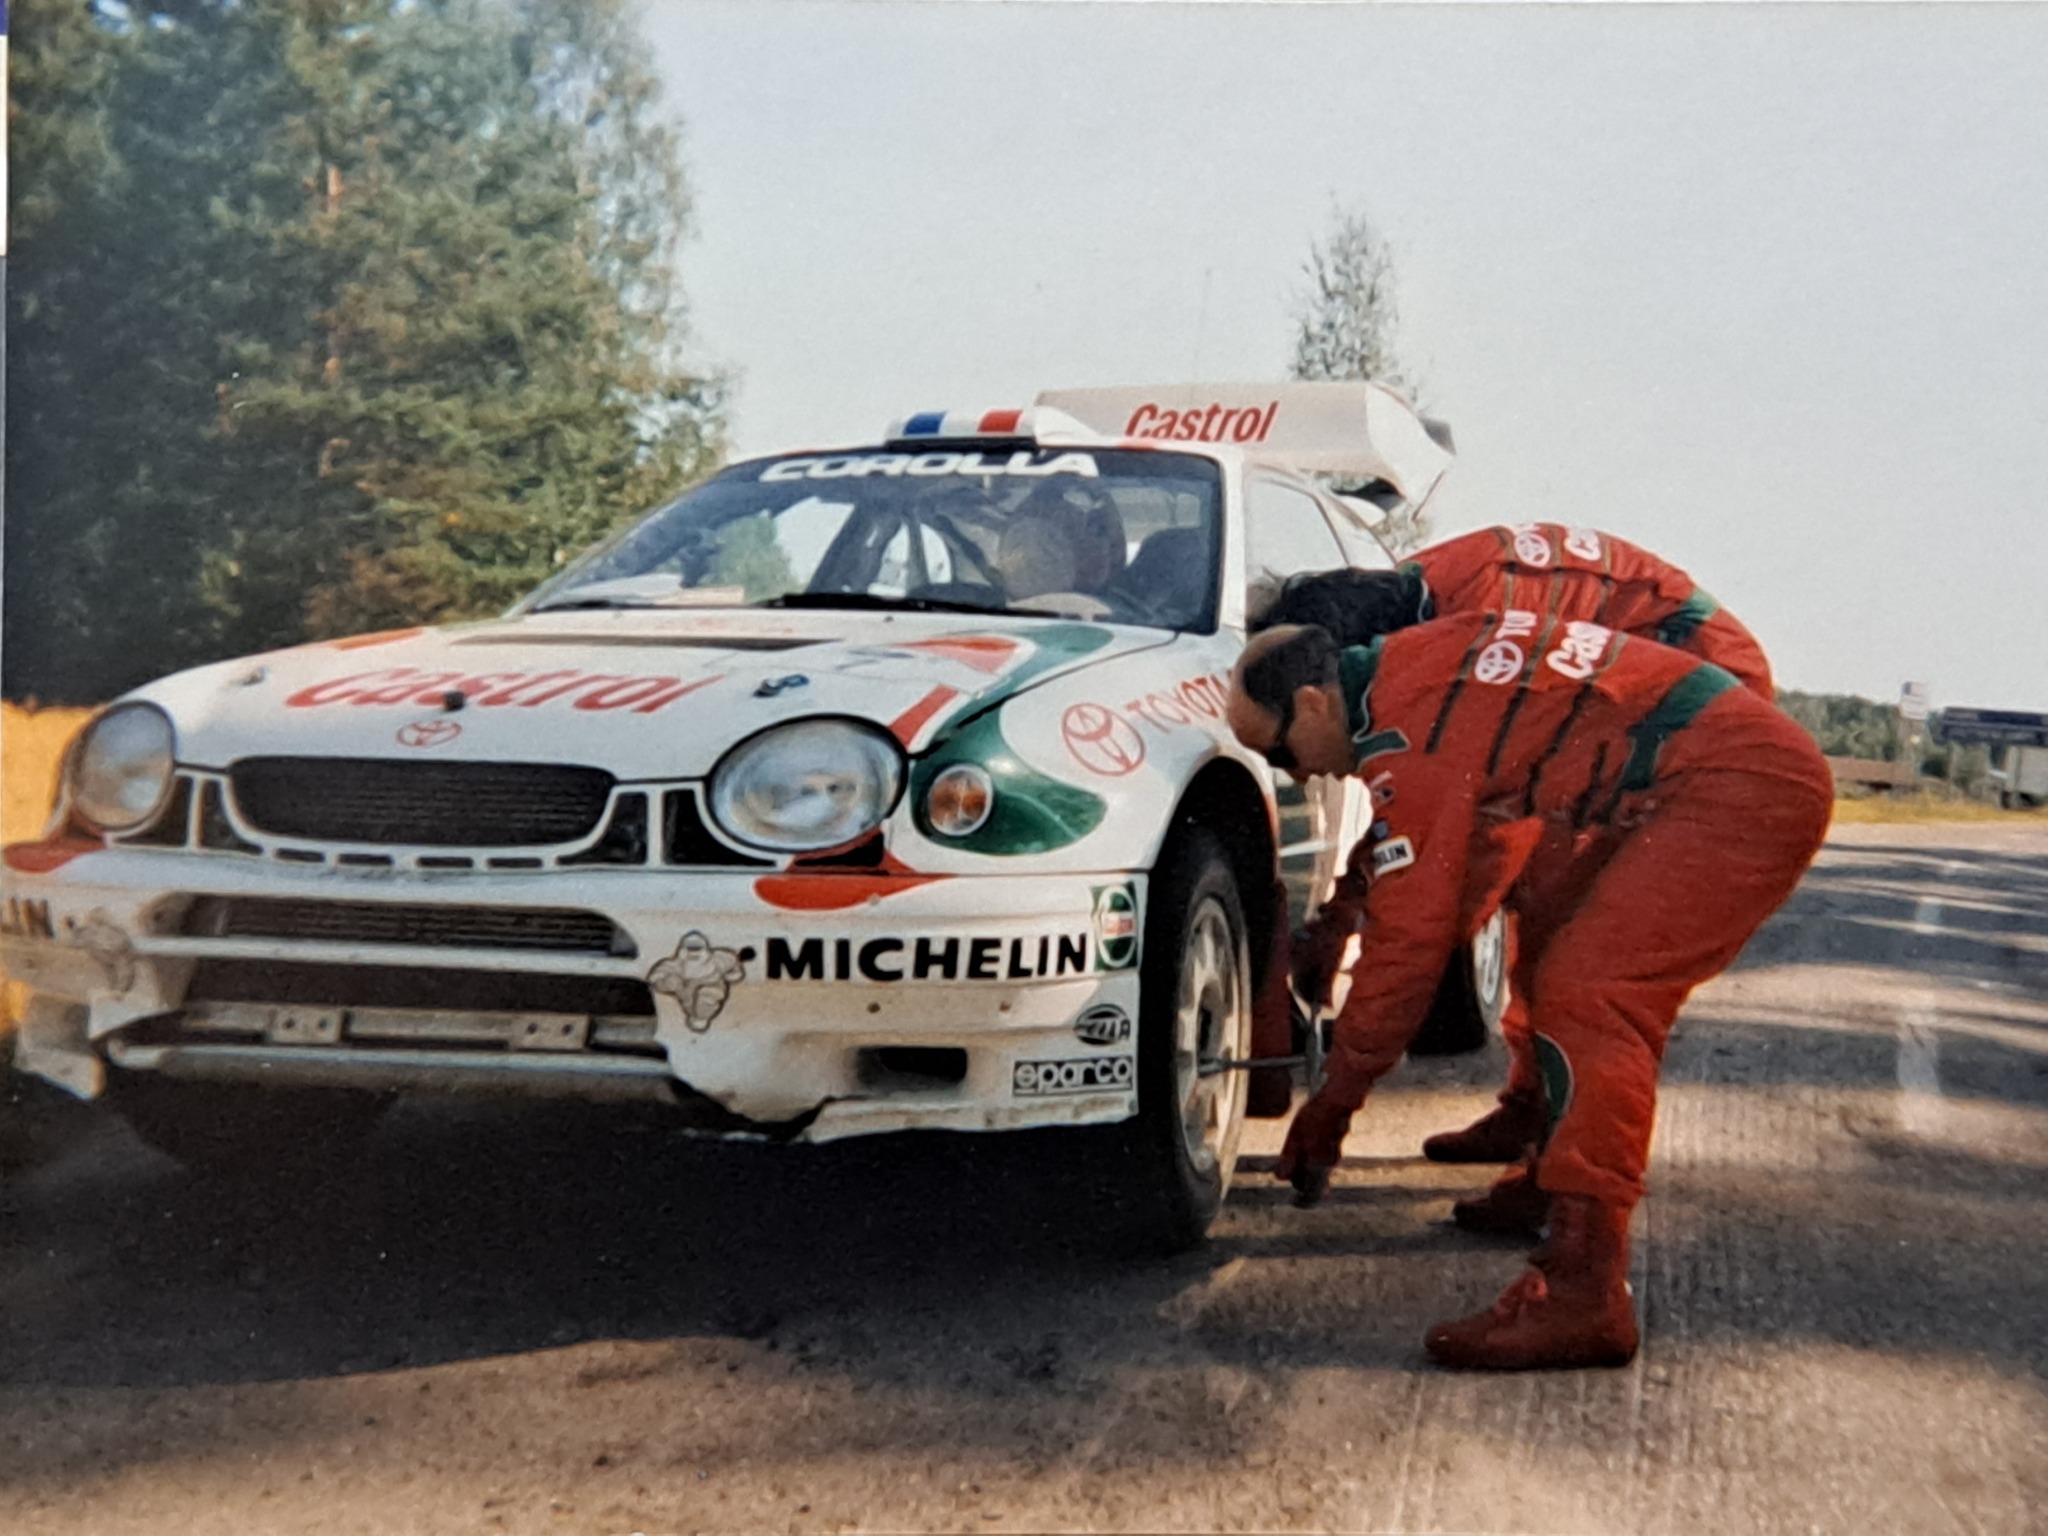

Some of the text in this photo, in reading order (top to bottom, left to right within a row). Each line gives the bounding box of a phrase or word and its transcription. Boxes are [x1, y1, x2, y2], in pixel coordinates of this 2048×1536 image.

[1125, 401, 1279, 442] Castrol
[759, 452, 1099, 482] COROLLA
[286, 668, 726, 714] Castrol
[766, 933, 1087, 982] MICHELIN
